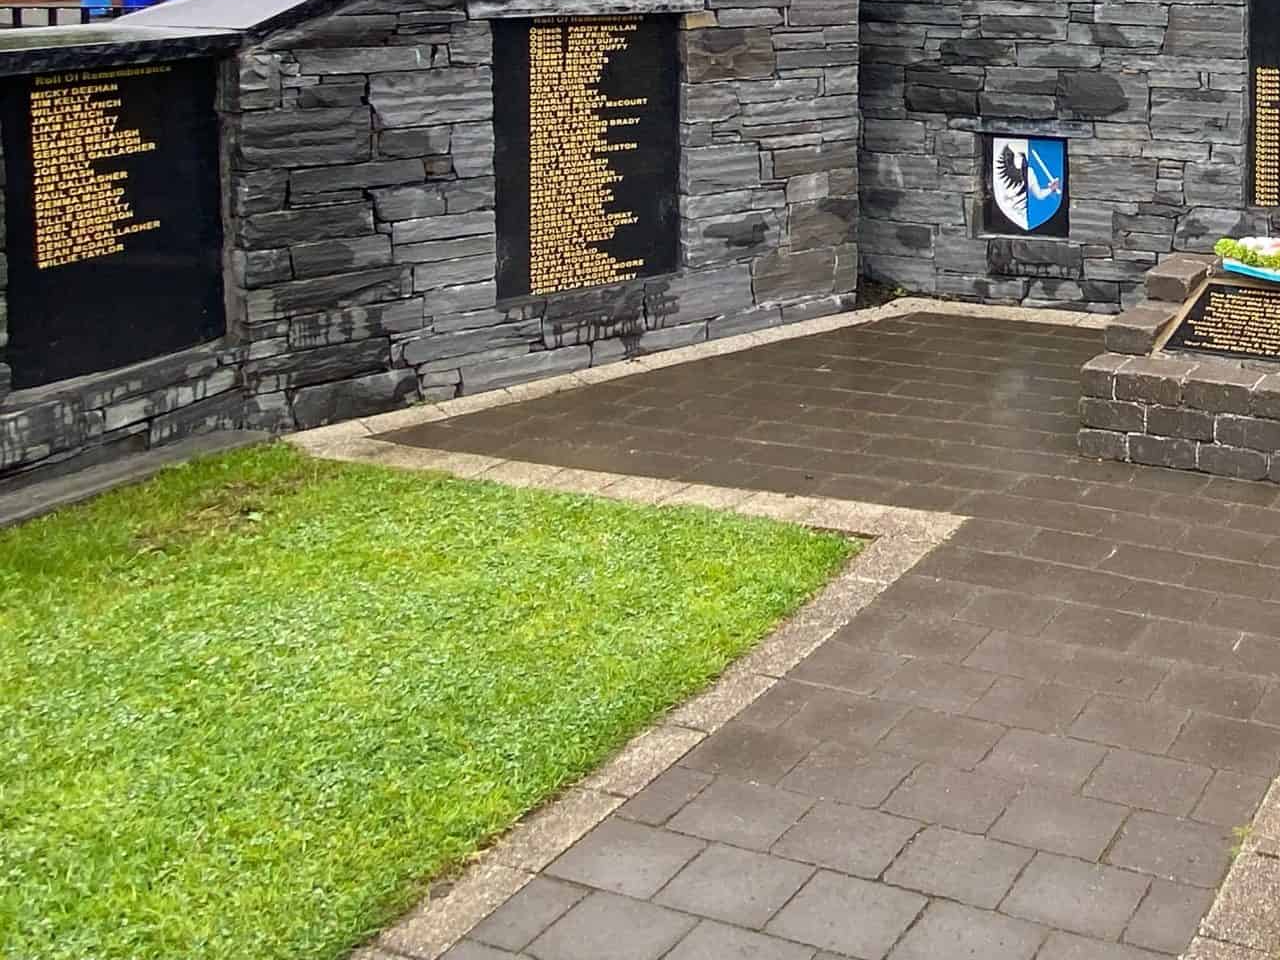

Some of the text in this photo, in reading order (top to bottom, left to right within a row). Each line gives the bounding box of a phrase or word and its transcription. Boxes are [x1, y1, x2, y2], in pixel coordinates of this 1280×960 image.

[30, 89, 69, 99] MICKY
[31, 95, 91, 107] JIM KELLY
[31, 100, 121, 116] WILLIAM LYNCH
[31, 110, 103, 124] JAKE LYNCH
[32, 117, 118, 133] LIAM HEGARTY
[32, 125, 115, 141] LILY HEGARTY
[33, 138, 82, 150] SEAMUS
[33, 146, 83, 158] GERARD
[33, 143, 155, 166] CHARLIE GALLAGHER
[34, 161, 90, 175] JOE DALY
[34, 169, 94, 184] ANN NASH
[35, 172, 128, 192] JIM GALLAGHER
[35, 183, 112, 201] PAUL CARLIN
[35, 189, 125, 210] GEMMA McDAID
[36, 198, 120, 218] PHIL DOHERTY
[36, 204, 129, 226] TILLIE DOHERTY
[36, 212, 133, 235] NOEL FERGUSON
[94, 222, 160, 240] GALLAGHER
[37, 223, 113, 243] PAUL BROWN
[38, 239, 115, 260] SEAN McDAID
[38, 245, 124, 268] WILLIE TAYLOR
